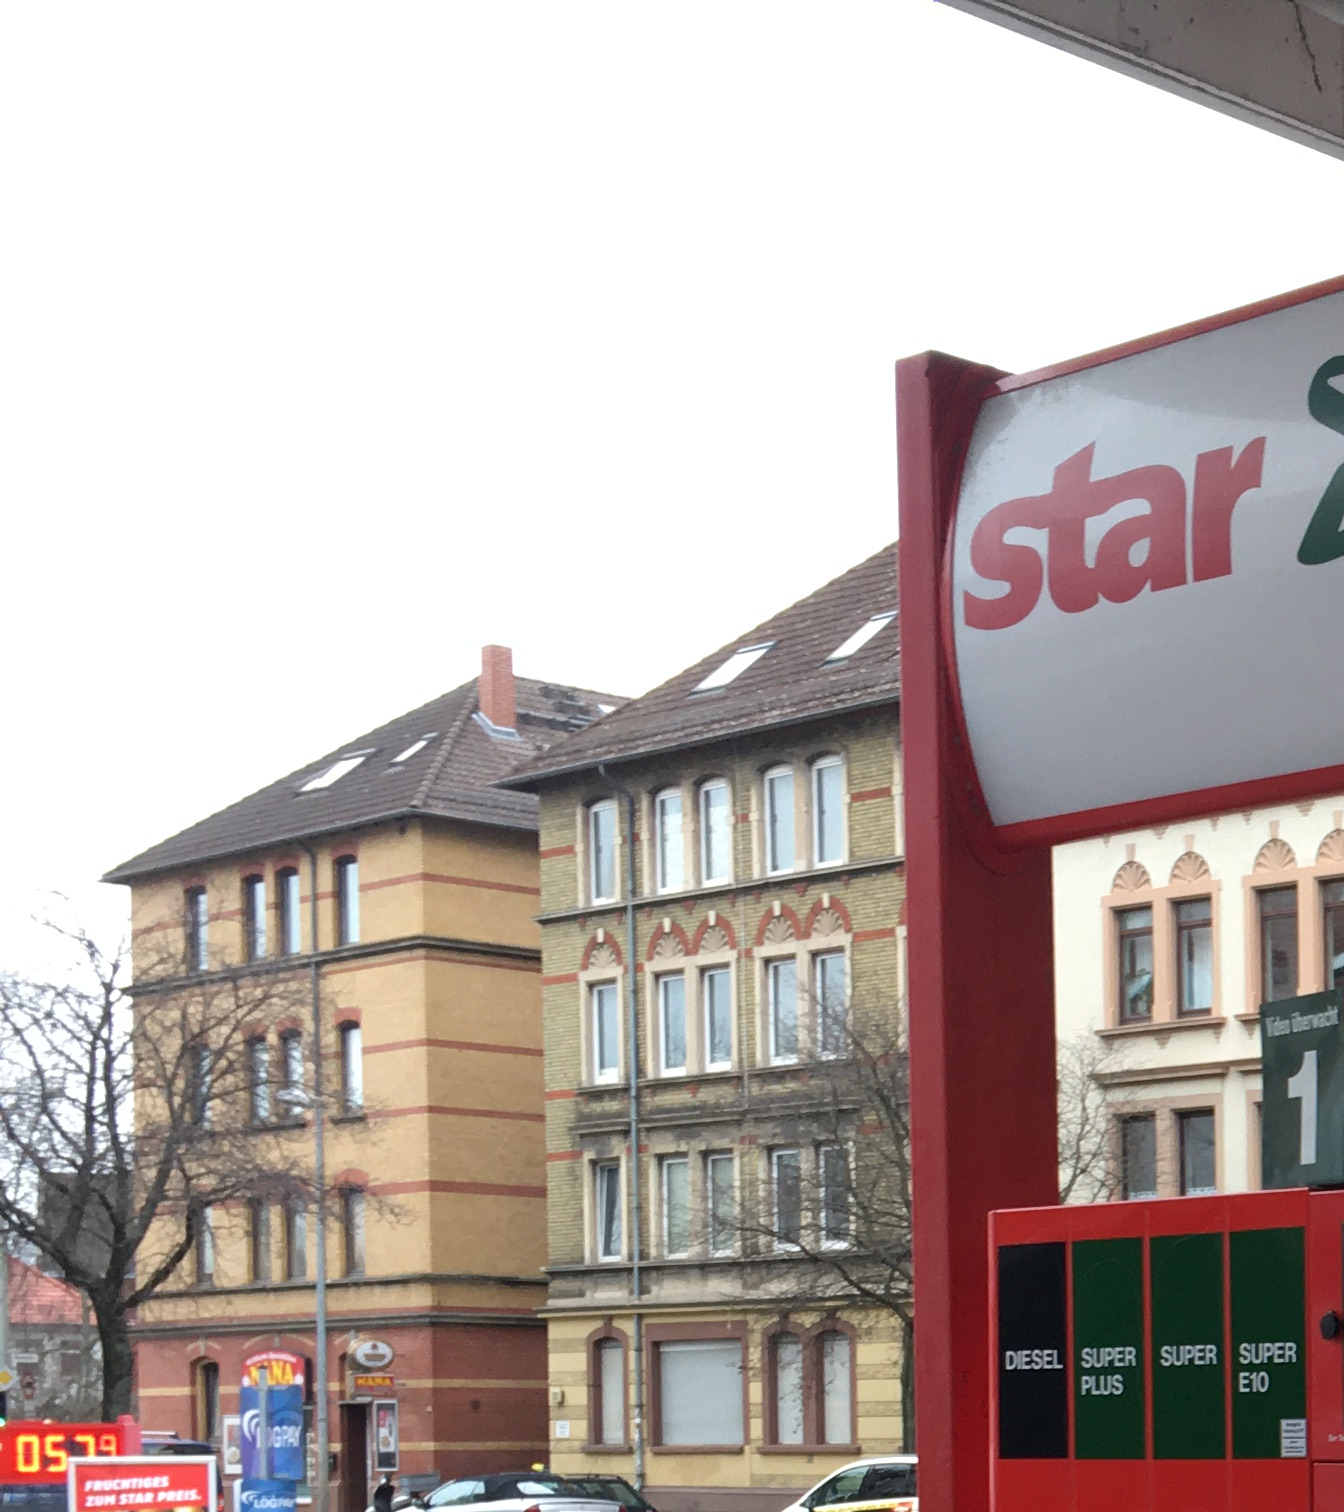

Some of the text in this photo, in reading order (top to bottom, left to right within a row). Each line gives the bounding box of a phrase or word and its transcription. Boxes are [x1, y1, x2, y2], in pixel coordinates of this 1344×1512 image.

[962, 436, 1264, 631] star
[1287, 1050, 1319, 1165] 1
[1005, 1350, 1063, 1371] DIESEL
[1081, 1347, 1136, 1368] SUPER
[1160, 1345, 1217, 1367] SUPER
[1238, 1342, 1297, 1365] SUPER
[1081, 1375, 1123, 1396] PLUS
[1238, 1371, 1269, 1393] E10
[84, 1476, 169, 1492] FRUCHTIGES
[85, 1489, 202, 1507] ZUM STAR PREIS.
